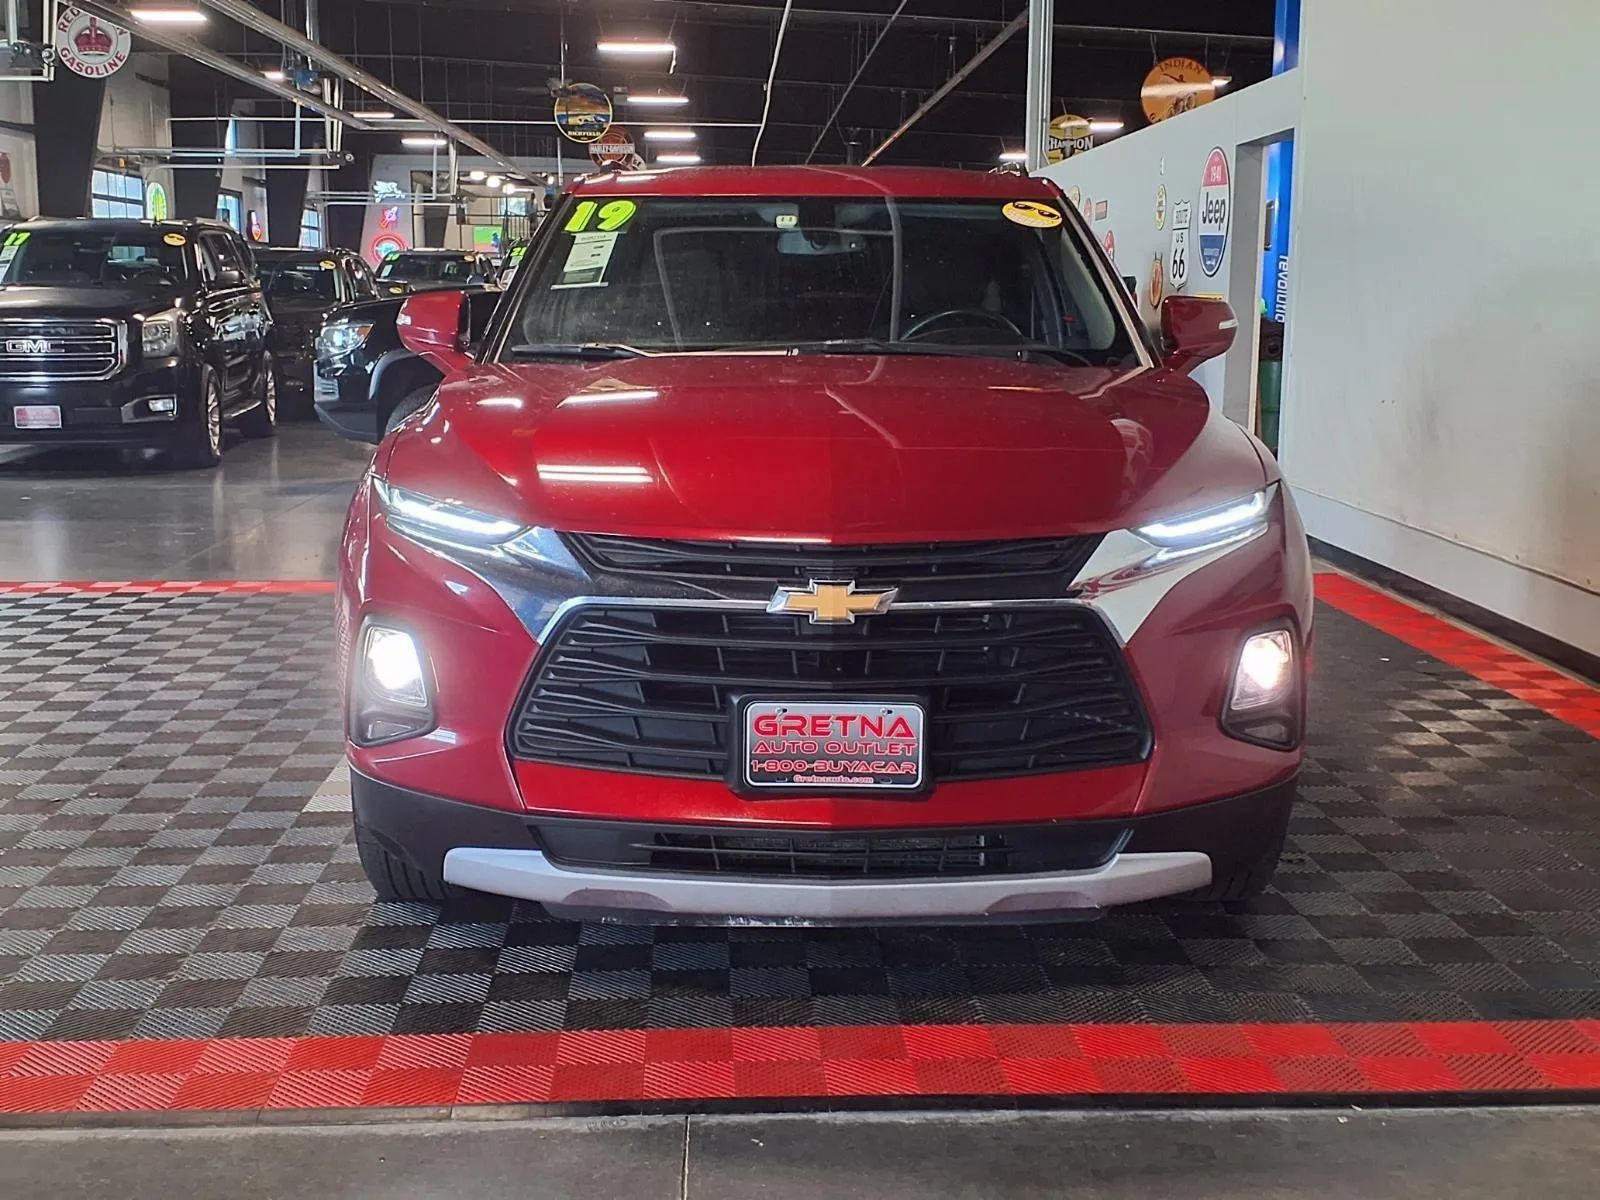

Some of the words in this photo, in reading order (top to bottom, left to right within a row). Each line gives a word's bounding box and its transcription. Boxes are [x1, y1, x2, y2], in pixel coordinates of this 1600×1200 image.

[60, 47, 126, 76] GASOLINE
[1159, 60, 1204, 75] INDIAN
[1210, 165, 1222, 182] 1941
[564, 200, 637, 232] 19
[1202, 192, 1226, 231] Jeep
[4, 232, 31, 246] 17
[1175, 232, 1184, 243] US
[1172, 247, 1185, 279] 66
[6, 340, 65, 352] GMC
[752, 715, 916, 739] GRETNA
[752, 741, 818, 755] AUTO
[824, 741, 918, 756] OUTLET
[751, 760, 917, 775] 1-800-BUYACAR
[793, 774, 874, 784] Gretnaauto.com
